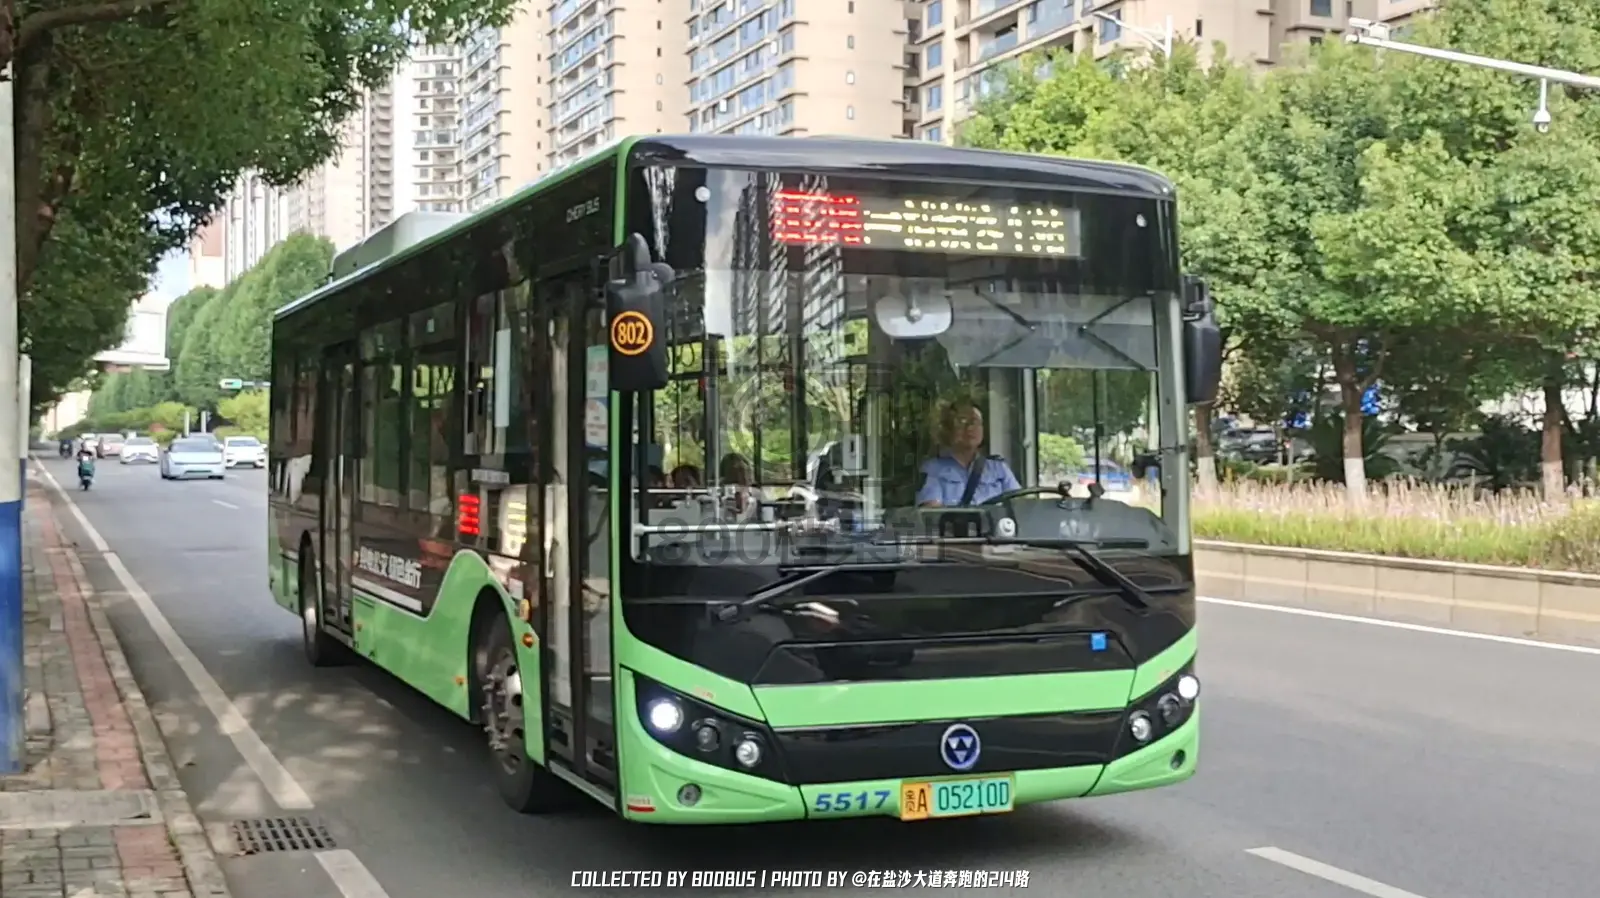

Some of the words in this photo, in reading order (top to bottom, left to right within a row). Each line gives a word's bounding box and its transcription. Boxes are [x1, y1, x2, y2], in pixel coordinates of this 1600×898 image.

[617, 321, 646, 345] 802
[814, 790, 891, 812] 5517
[905, 787, 928, 813] 贵A
[937, 781, 1010, 811] 05210D
